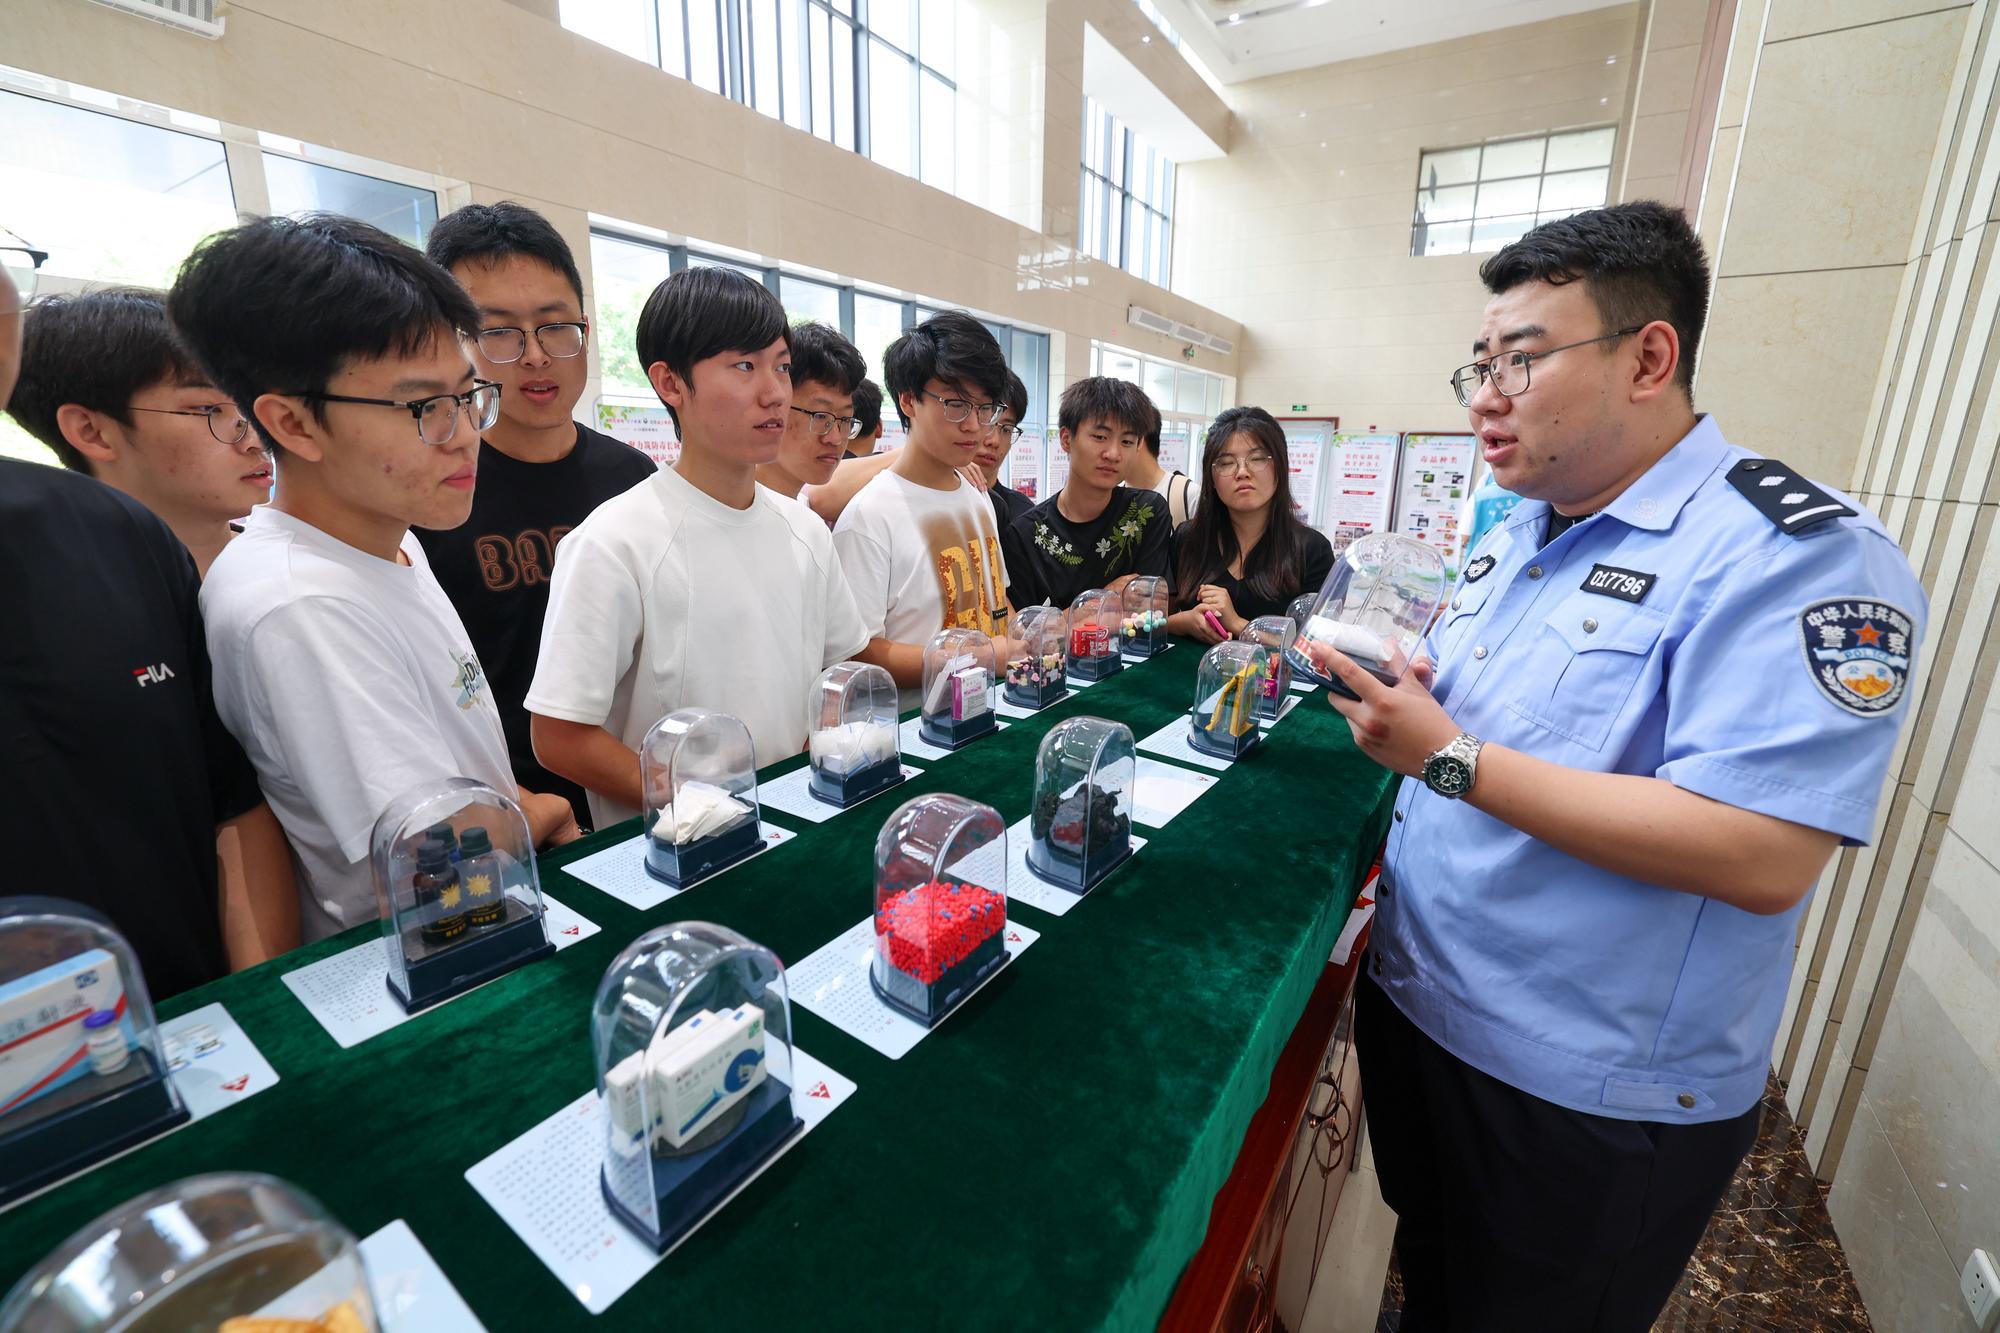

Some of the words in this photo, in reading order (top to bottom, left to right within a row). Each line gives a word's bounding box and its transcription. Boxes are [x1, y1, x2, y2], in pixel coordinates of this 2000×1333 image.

[1590, 570, 1646, 595] 017796
[1806, 603, 1911, 638] 中华人民共和国
[1843, 648, 1890, 661] POLICE
[132, 663, 175, 687] FILA
